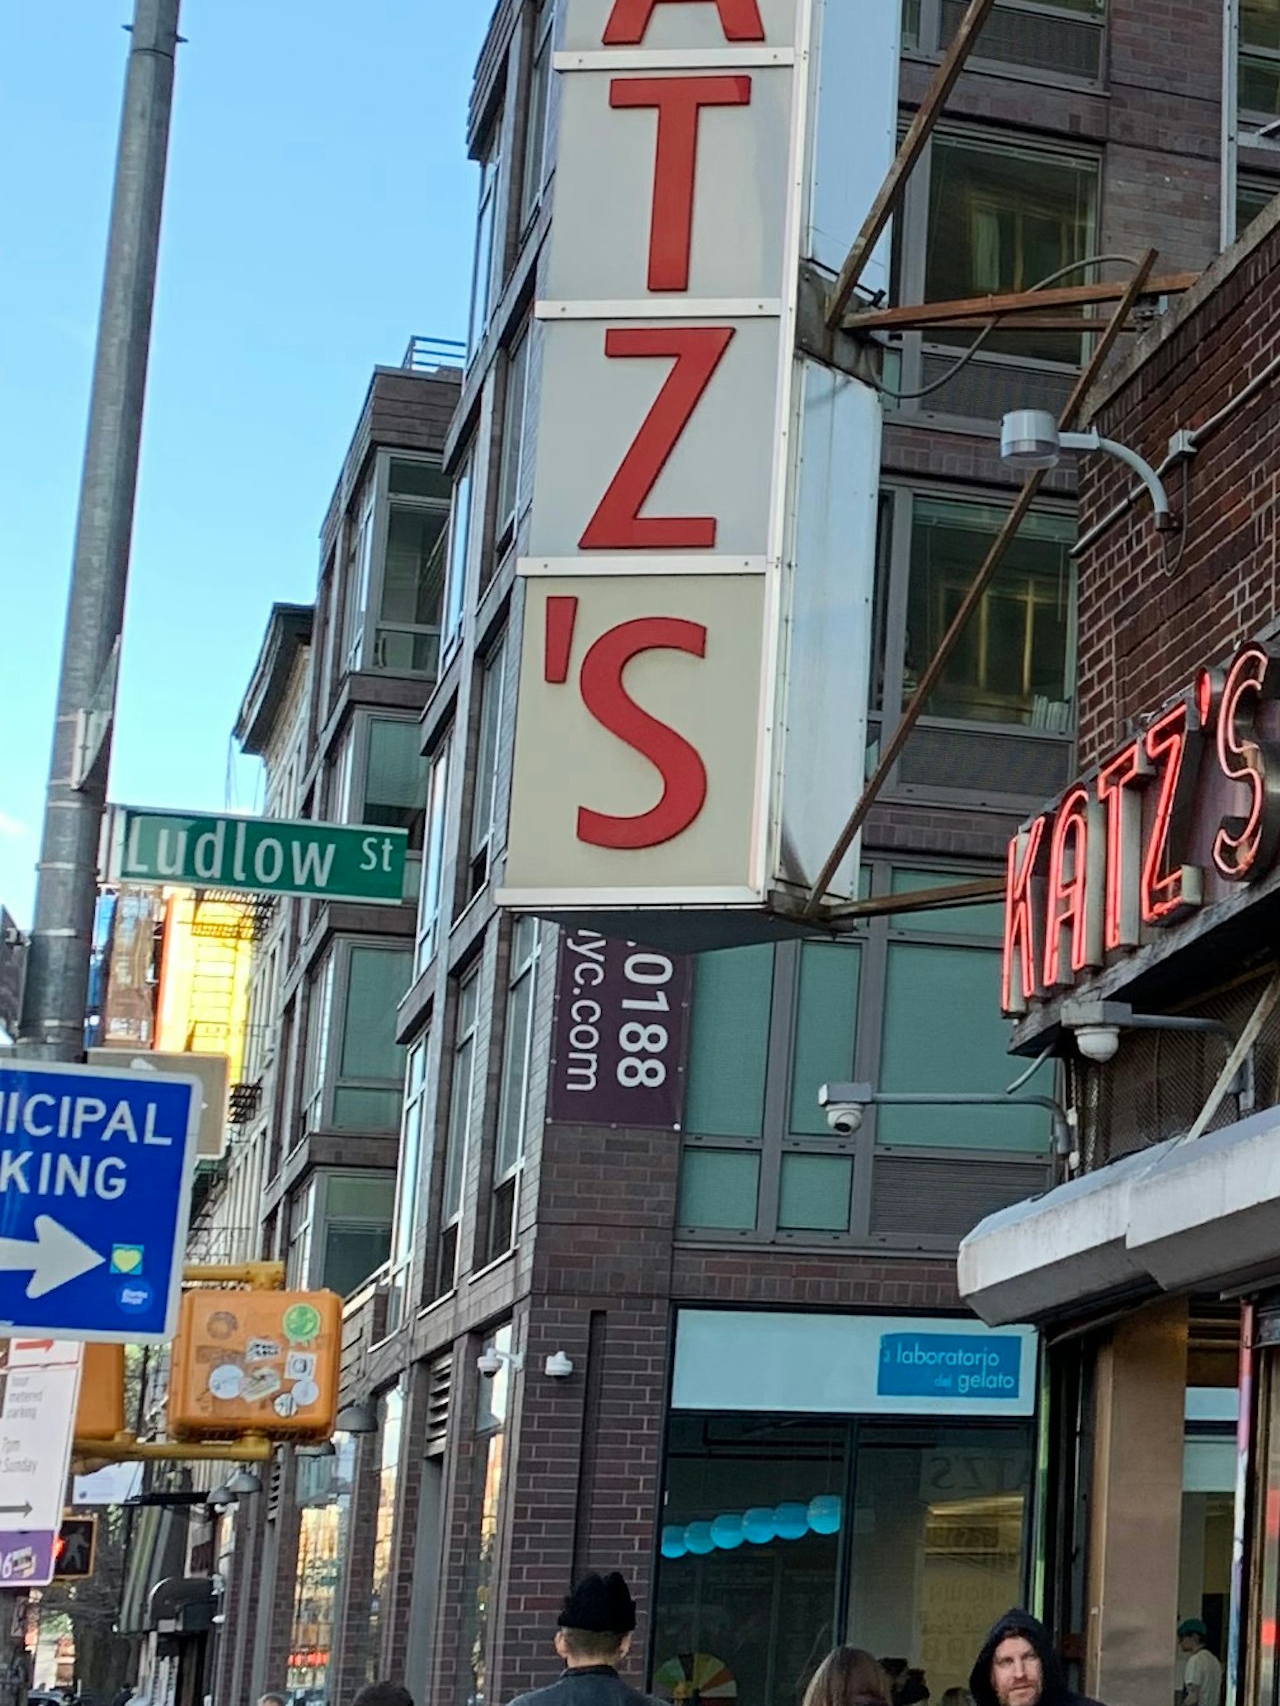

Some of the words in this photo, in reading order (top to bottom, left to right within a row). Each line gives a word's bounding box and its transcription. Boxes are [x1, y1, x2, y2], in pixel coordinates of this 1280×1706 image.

[126, 815, 336, 887] Ludlow
[359, 837, 393, 872] St
[0, 1091, 172, 1145] ICIPAL
[0, 1149, 127, 1200] KING
[896, 1341, 1000, 1368] laboratorio
[957, 1367, 1015, 1394] gelato
